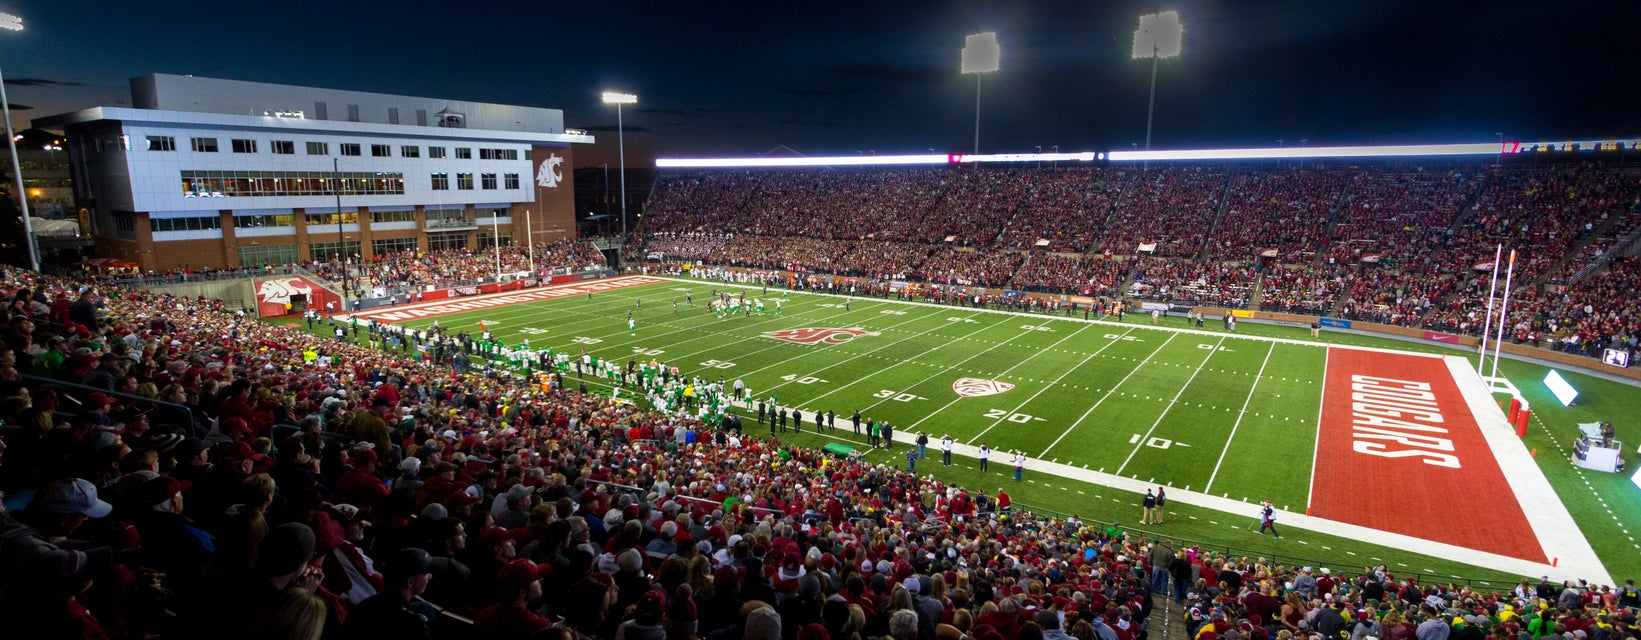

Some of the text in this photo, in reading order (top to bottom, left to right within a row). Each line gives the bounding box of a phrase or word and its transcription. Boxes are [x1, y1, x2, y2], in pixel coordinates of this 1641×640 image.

[371, 277, 661, 320] WASHINGTON STATE
[632, 346, 665, 356] 40
[1606, 350, 1625, 365] 29
[700, 359, 737, 369] 50
[780, 373, 820, 385] 40
[873, 389, 917, 403] 30
[982, 408, 1033, 424] 20
[1351, 374, 1461, 469] COUGARS
[1129, 433, 1172, 449] 10
[1592, 595, 1601, 604] 10
